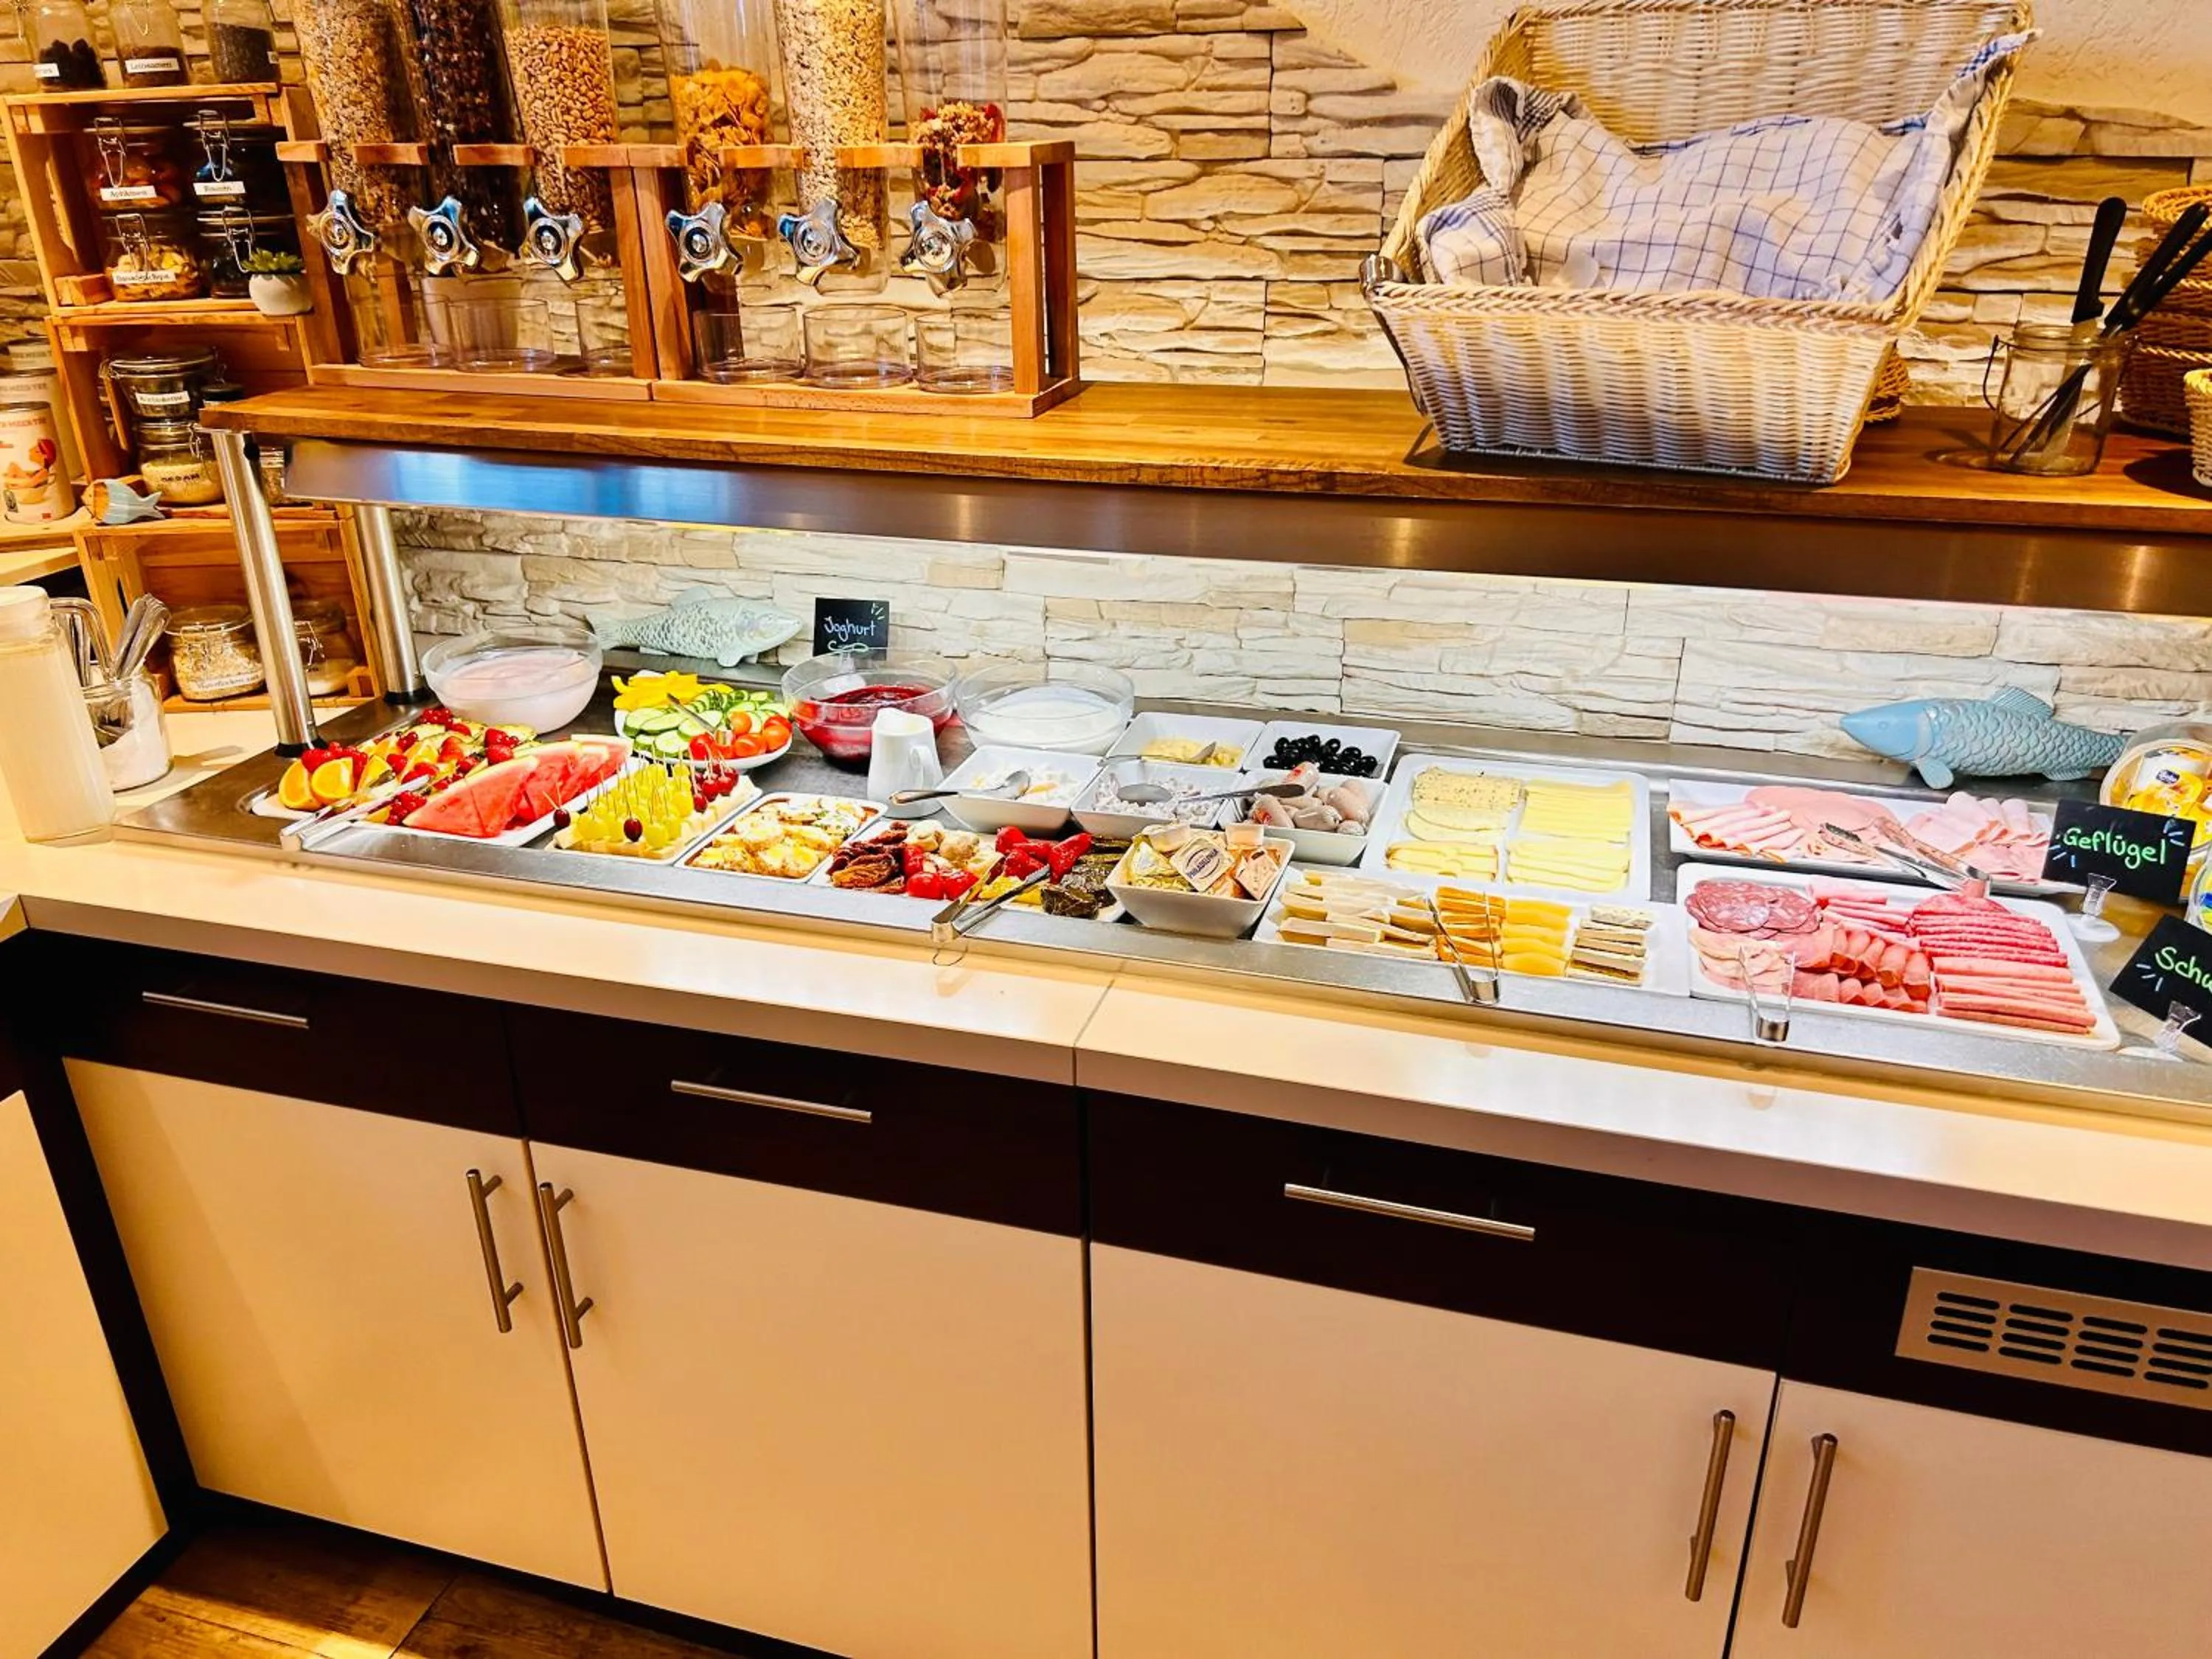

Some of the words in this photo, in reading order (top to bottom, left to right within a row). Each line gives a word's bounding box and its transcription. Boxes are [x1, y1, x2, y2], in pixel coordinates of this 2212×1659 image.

[824, 616, 876, 642] Joghurt
[1186, 848, 1219, 880] PHILADELPHIA
[2063, 827, 2166, 869] Geflügel
